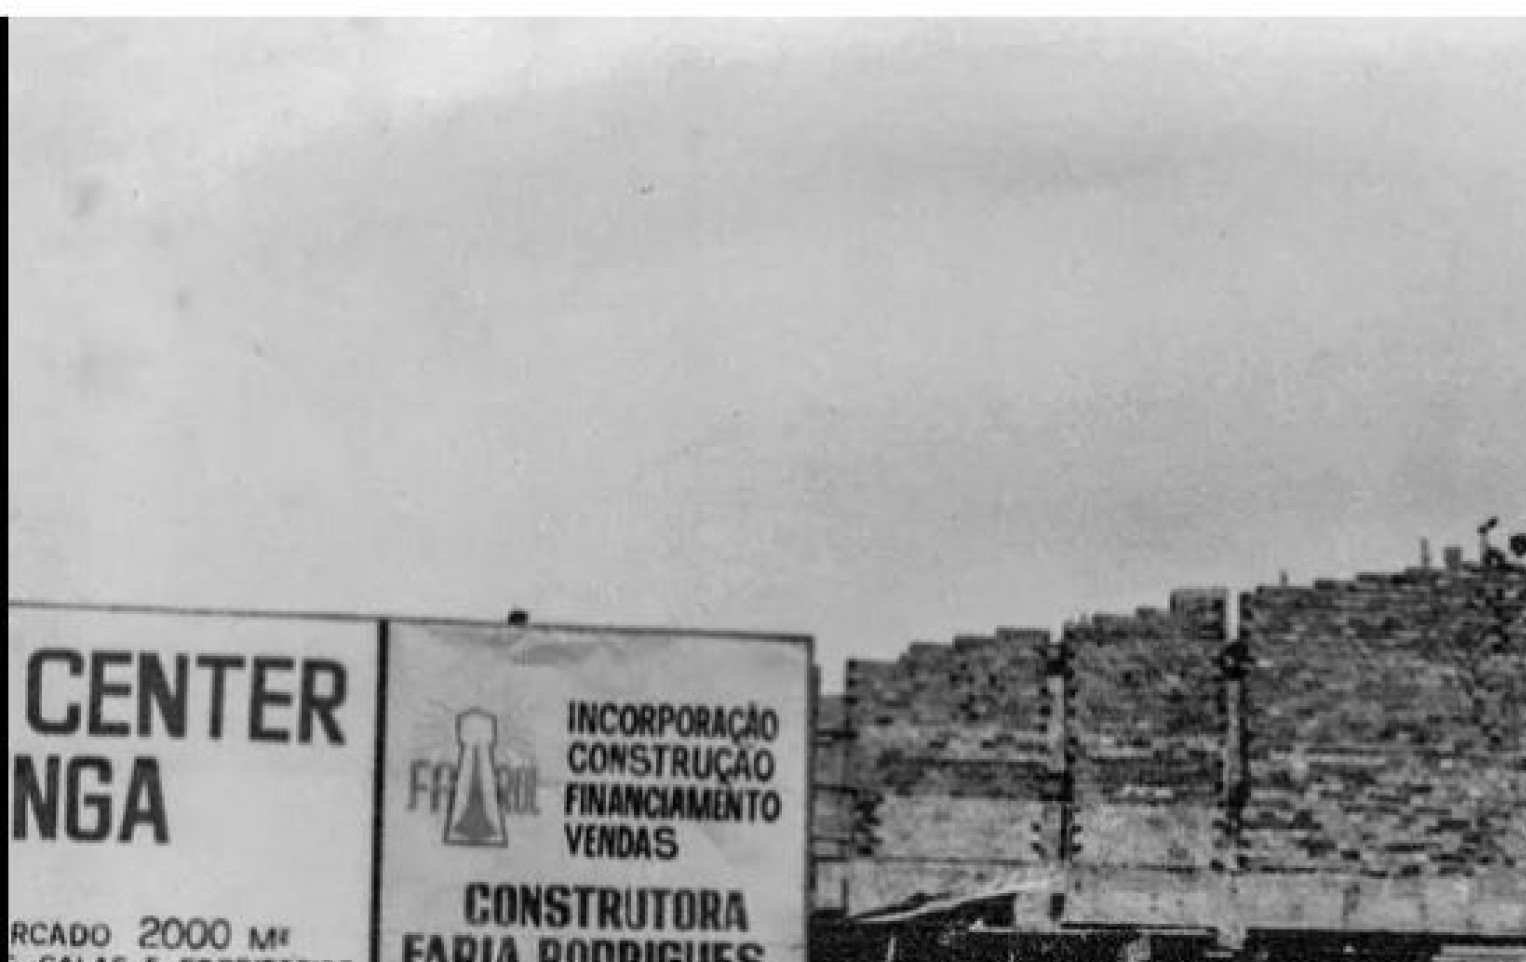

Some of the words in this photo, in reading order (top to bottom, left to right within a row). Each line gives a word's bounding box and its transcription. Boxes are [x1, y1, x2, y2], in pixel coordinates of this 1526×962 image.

[25, 648, 347, 745] CENTER
[12, 753, 170, 844] NGA
[562, 782, 783, 826] FINANCIAMENTO
[562, 822, 680, 861] VENDAS
[463, 880, 751, 933] CONSTRUTORA
[11, 921, 111, 947] RCADO
[138, 915, 232, 950] 2000
